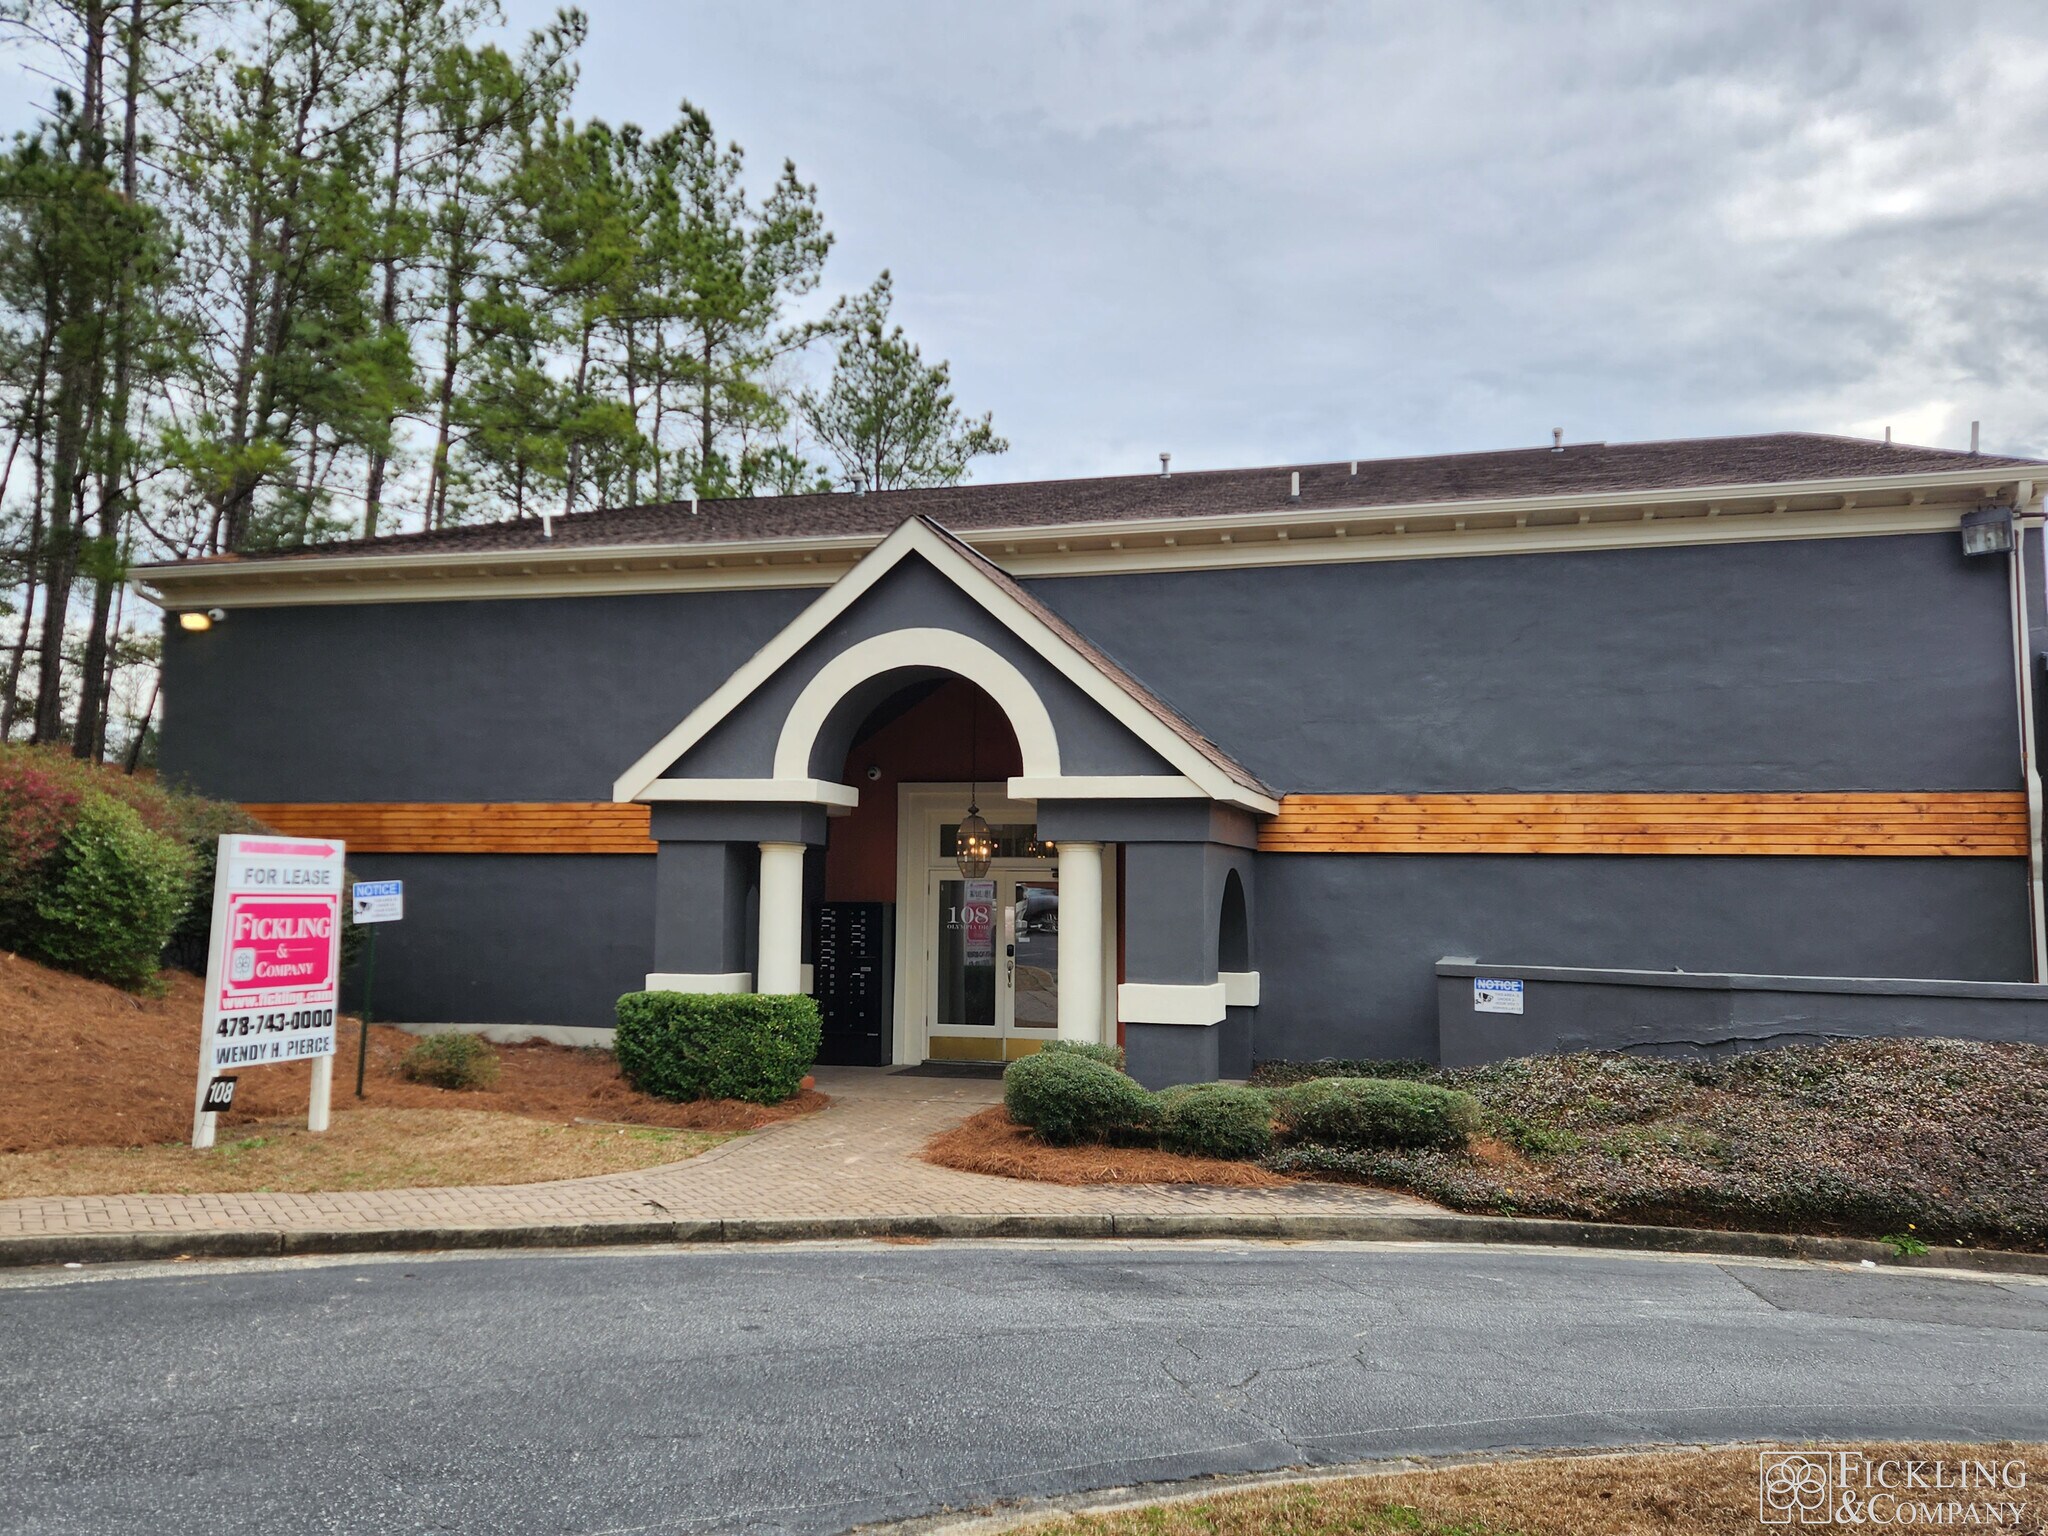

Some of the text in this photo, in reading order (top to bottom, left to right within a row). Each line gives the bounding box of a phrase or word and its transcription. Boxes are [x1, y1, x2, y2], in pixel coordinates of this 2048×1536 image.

[243, 868, 330, 885] FOR LEASE
[356, 883, 398, 897] NOTICE
[947, 906, 989, 924] 108
[234, 912, 331, 941] FICKLING
[276, 943, 289, 959] &
[255, 961, 315, 978] COMPANY
[1477, 979, 1521, 991] NOTICE
[222, 989, 333, 1010] www.fickling.com
[216, 1008, 333, 1038] 478-743-0000
[216, 1037, 330, 1065] WENDY H. PIERCE
[209, 1081, 234, 1104] 108
